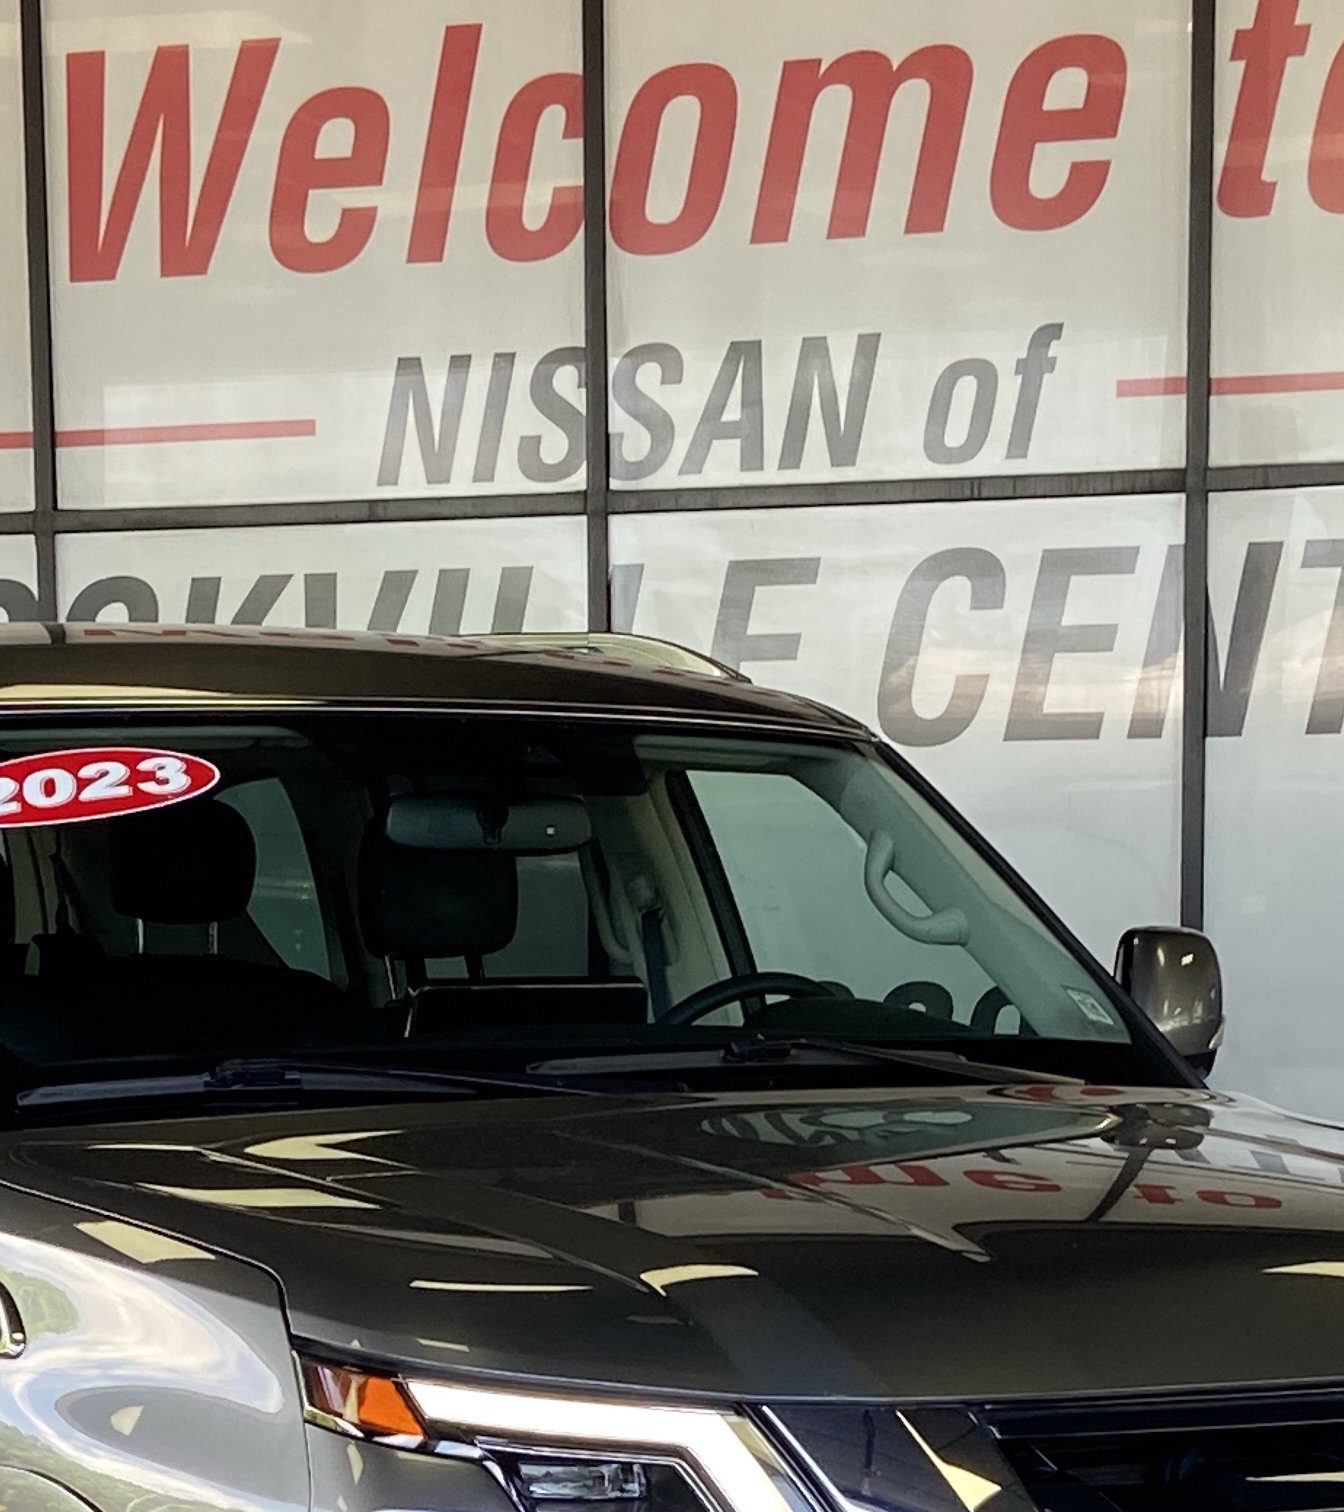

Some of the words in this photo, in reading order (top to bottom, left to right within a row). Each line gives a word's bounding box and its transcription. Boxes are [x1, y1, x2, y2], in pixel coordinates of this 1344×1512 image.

[66, 23, 1127, 283] Welcome
[376, 333, 882, 487] NISSAN
[922, 322, 1064, 466] of
